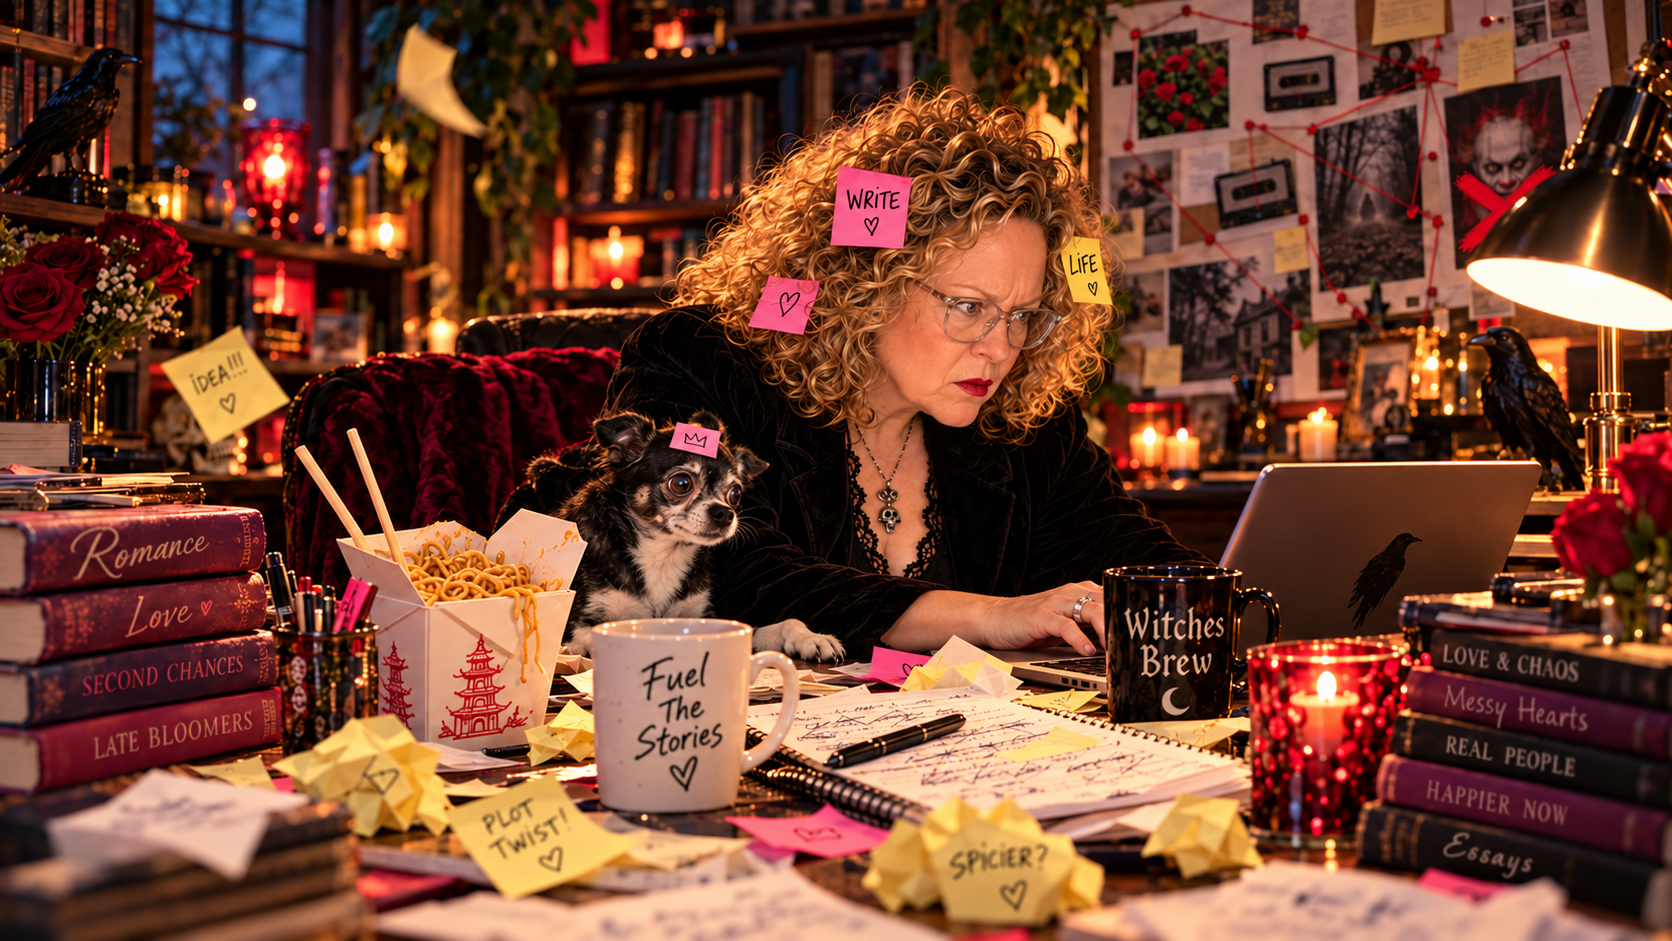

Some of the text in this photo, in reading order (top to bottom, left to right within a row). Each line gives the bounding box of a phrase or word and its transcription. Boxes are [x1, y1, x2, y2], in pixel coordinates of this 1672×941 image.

[70, 526, 210, 581] Romance
[125, 595, 193, 638] Love
[1124, 606, 1225, 641] Witches
[82, 655, 244, 697] SECOND CHANCES
[641, 651, 710, 701] Fuel
[1140, 644, 1212, 678] Brew
[1442, 644, 1580, 683] LOVE & CHAOS
[658, 695, 705, 724] The
[1443, 685, 1589, 732] Messy Hearts
[94, 710, 253, 760] LATE BLOOMERS
[634, 723, 723, 761] Stories
[1445, 735, 1577, 778] REAL PEOPLE
[482, 797, 534, 835] PLOT
[1426, 779, 1569, 826] HAPPIER NOW
[1443, 831, 1534, 879] Essays
